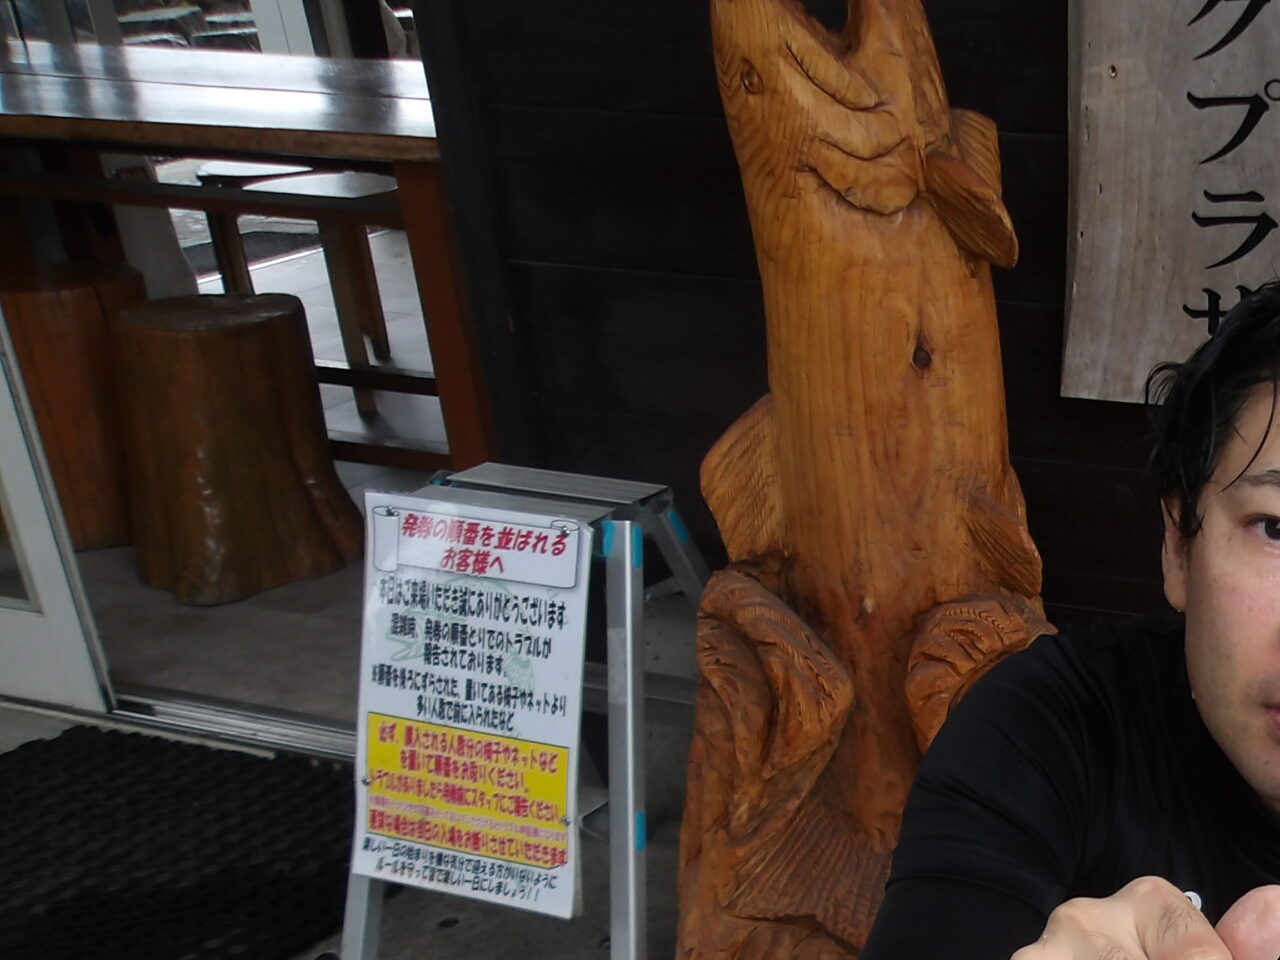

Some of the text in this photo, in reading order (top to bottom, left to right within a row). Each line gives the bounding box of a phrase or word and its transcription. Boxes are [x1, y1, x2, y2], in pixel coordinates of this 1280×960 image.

[401, 513, 569, 556] 発券の順番を並ばれる
[440, 547, 504, 574] お客様へ
